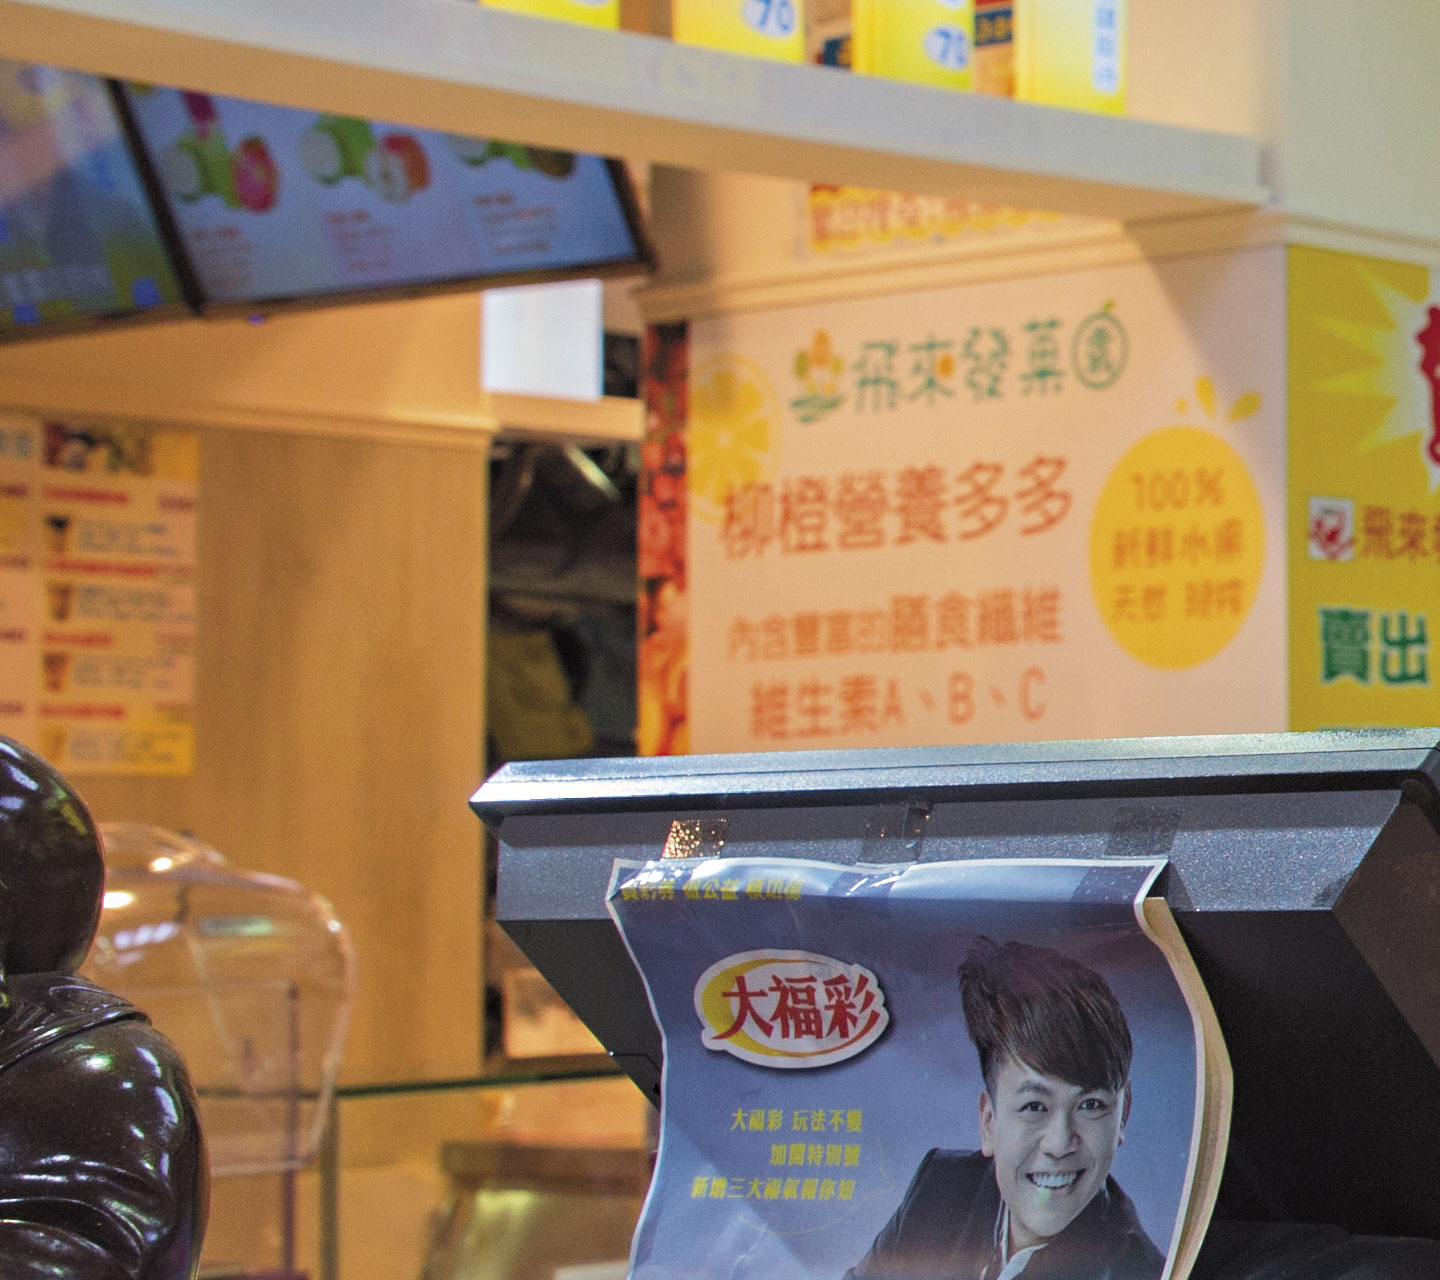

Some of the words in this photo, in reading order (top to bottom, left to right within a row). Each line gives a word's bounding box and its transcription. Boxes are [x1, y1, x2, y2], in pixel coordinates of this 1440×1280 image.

[719, 454, 1073, 561] 柳橙營養多多
[1132, 467, 1227, 511] 100%
[1318, 605, 1431, 687] 賣出
[712, 973, 886, 1040] 大福彩
[731, 1109, 783, 1131] 大福彩
